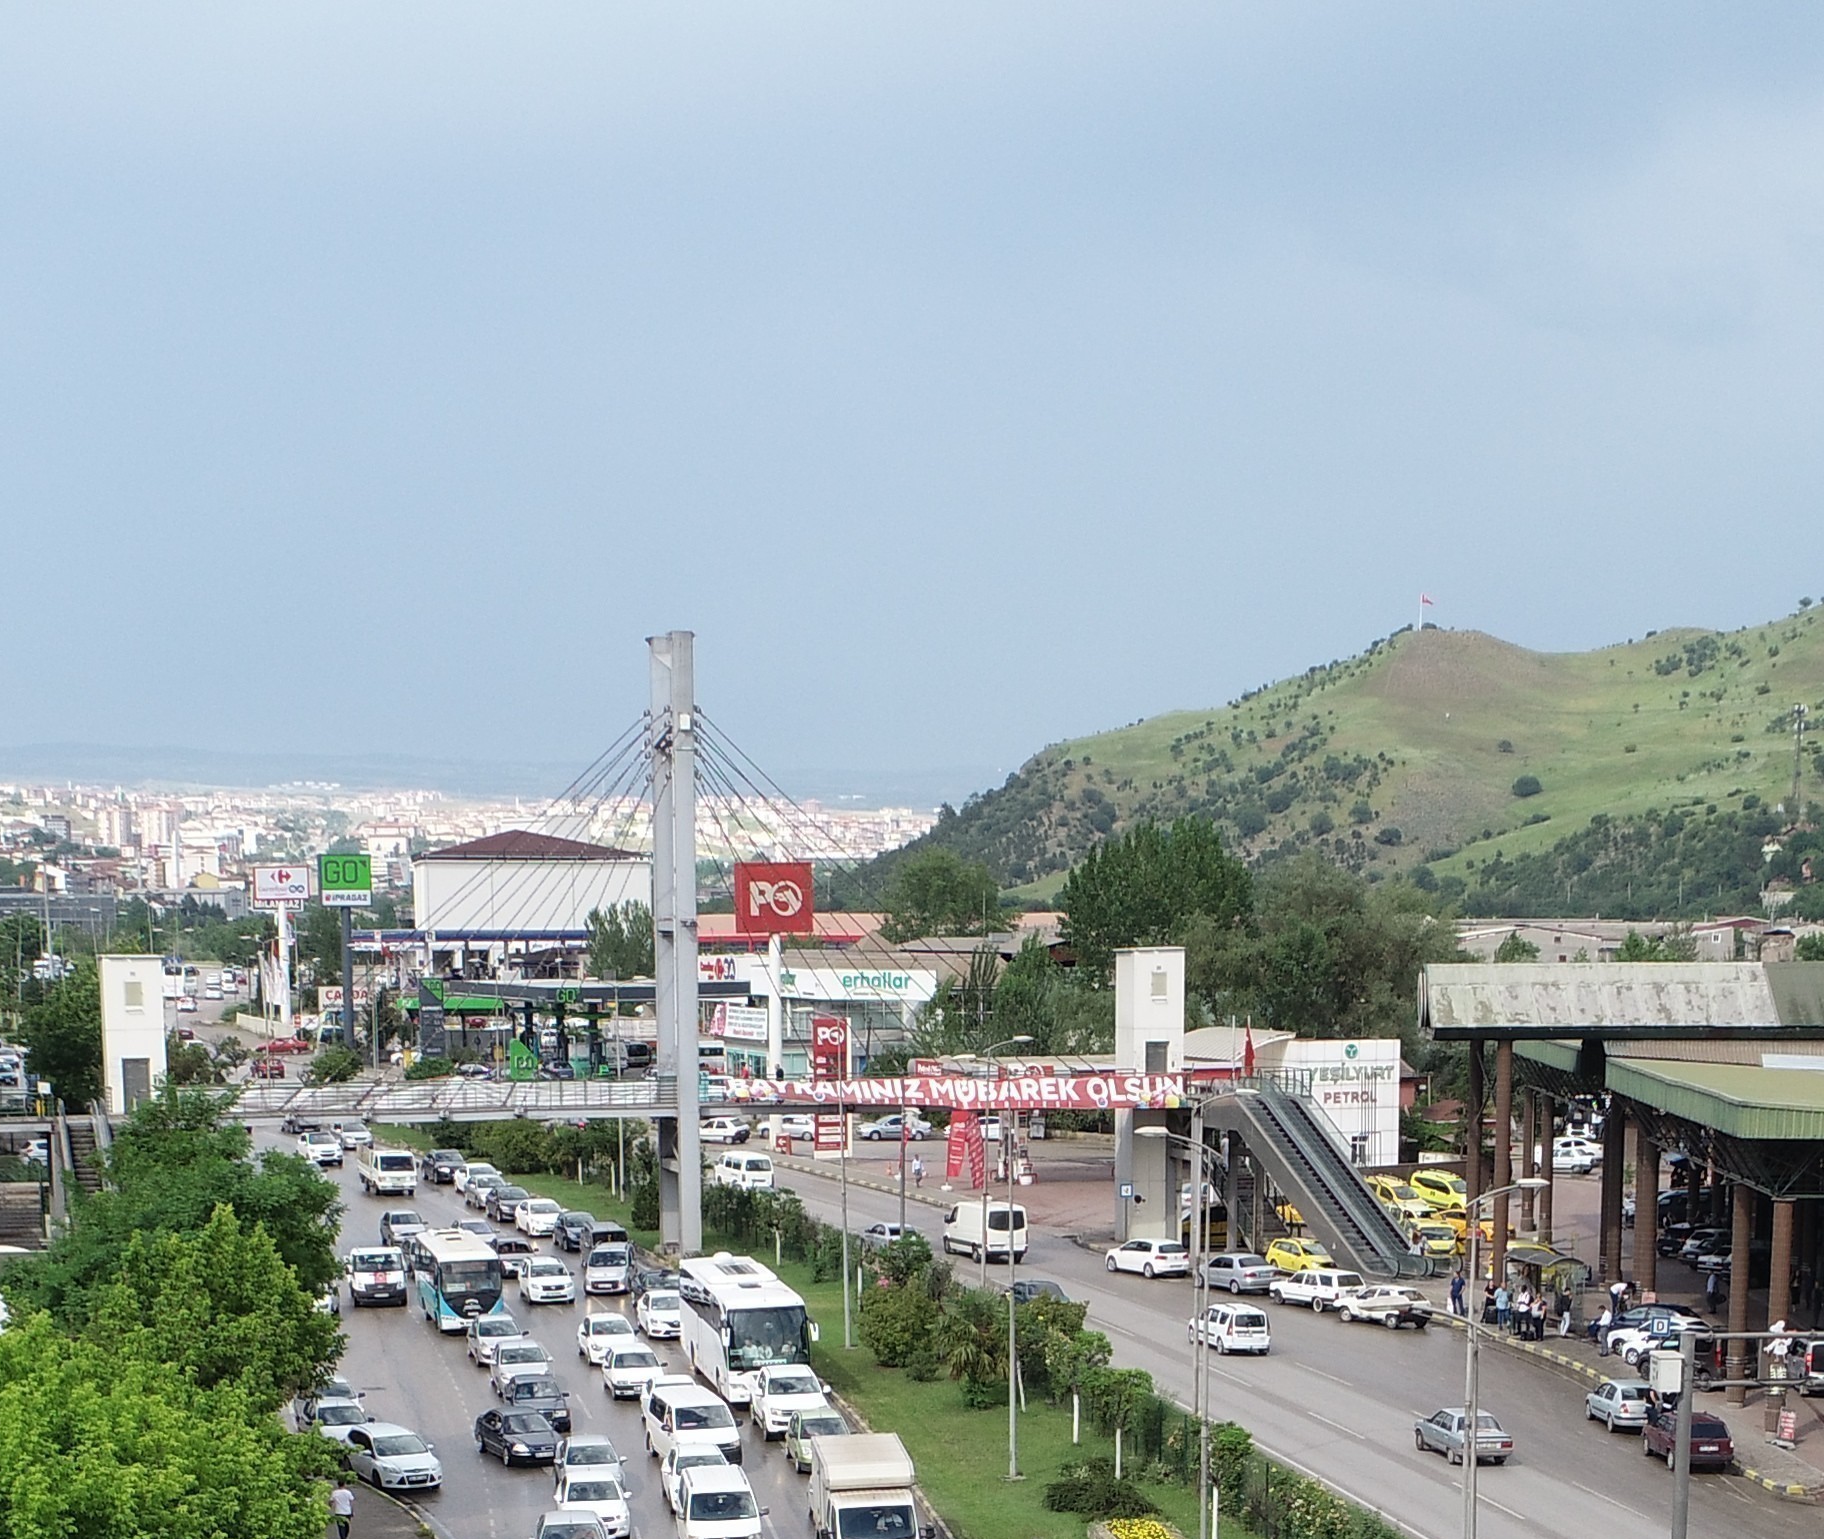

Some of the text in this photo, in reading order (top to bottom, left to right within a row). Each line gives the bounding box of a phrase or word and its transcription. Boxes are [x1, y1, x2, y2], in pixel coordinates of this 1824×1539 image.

[325, 860, 358, 884] GO
[1308, 1062, 1395, 1085] YEŞİLYURT
[929, 1076, 1078, 1103] MÜBAREK
[1086, 1077, 1184, 1102] OLSUN
[1323, 1091, 1378, 1104] PETROL
